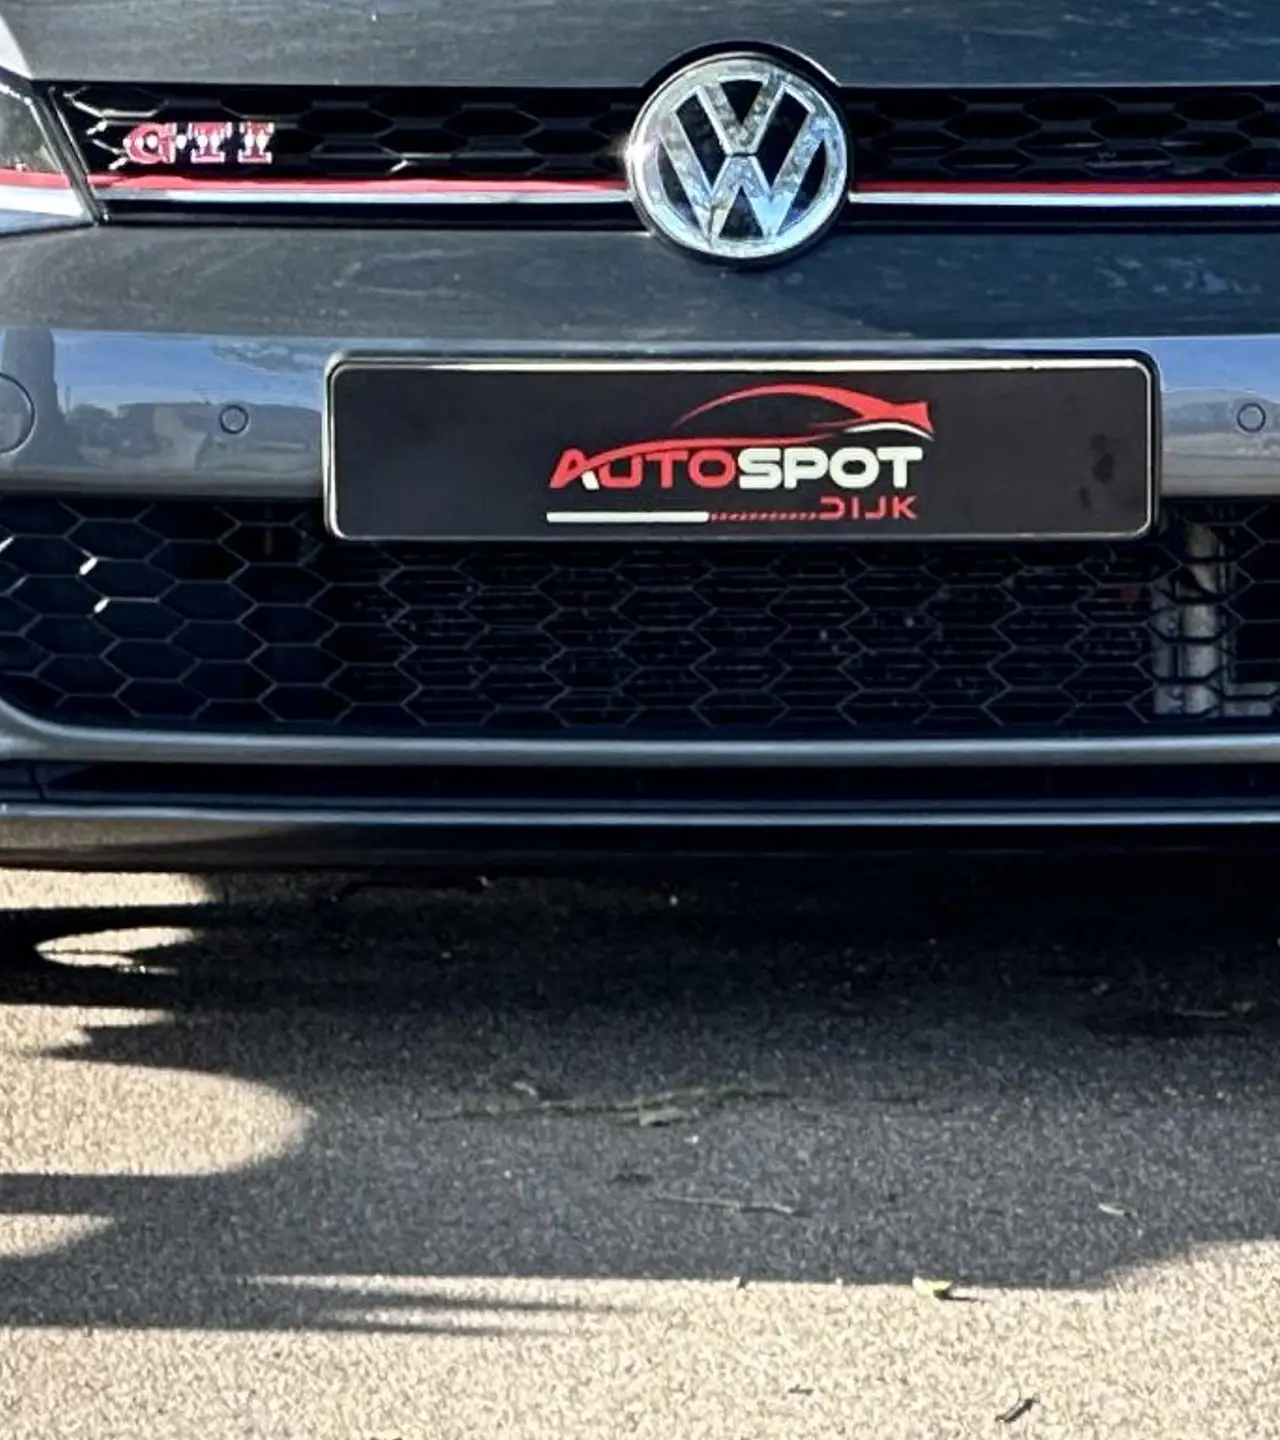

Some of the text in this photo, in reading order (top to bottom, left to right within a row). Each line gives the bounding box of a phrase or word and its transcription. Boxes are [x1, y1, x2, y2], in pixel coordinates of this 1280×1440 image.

[123, 121, 275, 164] GTI
[549, 446, 924, 491] AUTOSPOT
[819, 495, 920, 521] DIJK
